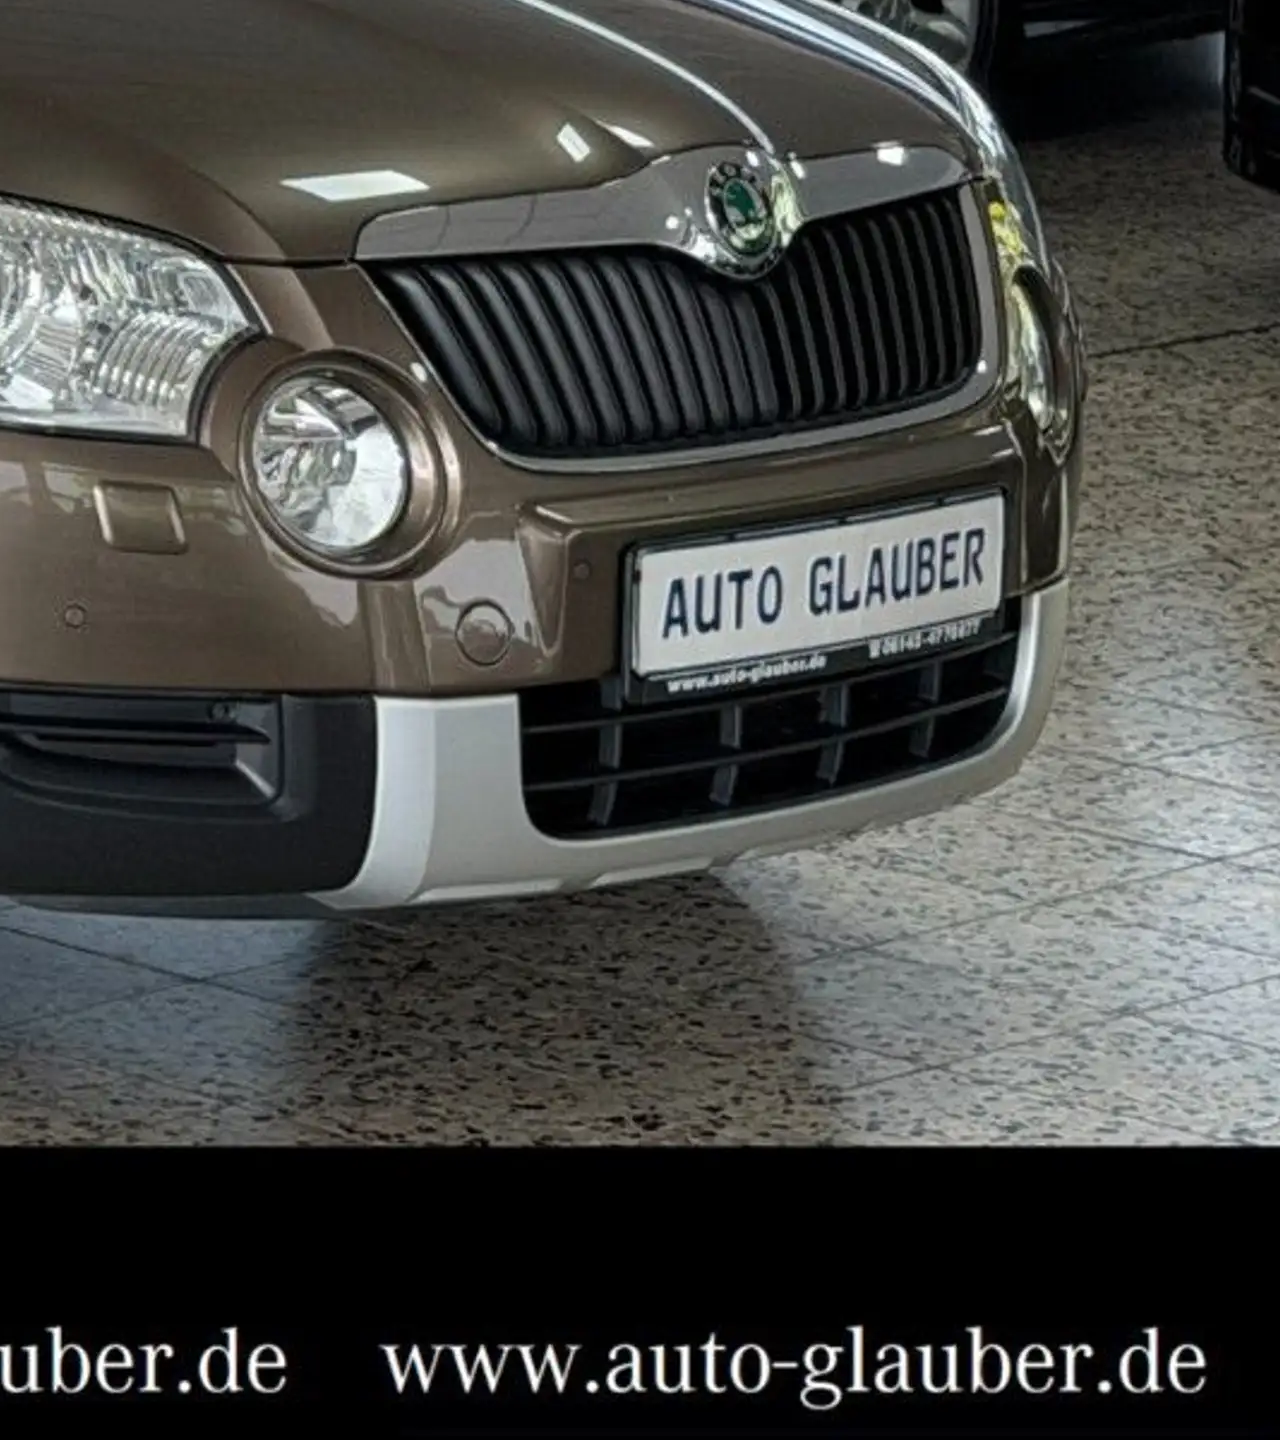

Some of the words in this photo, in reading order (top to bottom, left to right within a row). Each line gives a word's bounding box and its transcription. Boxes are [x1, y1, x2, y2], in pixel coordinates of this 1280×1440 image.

[662, 566, 784, 639] AUTO
[809, 527, 986, 616] GLAUBER
[667, 654, 827, 694] www.auto-glauber.de
